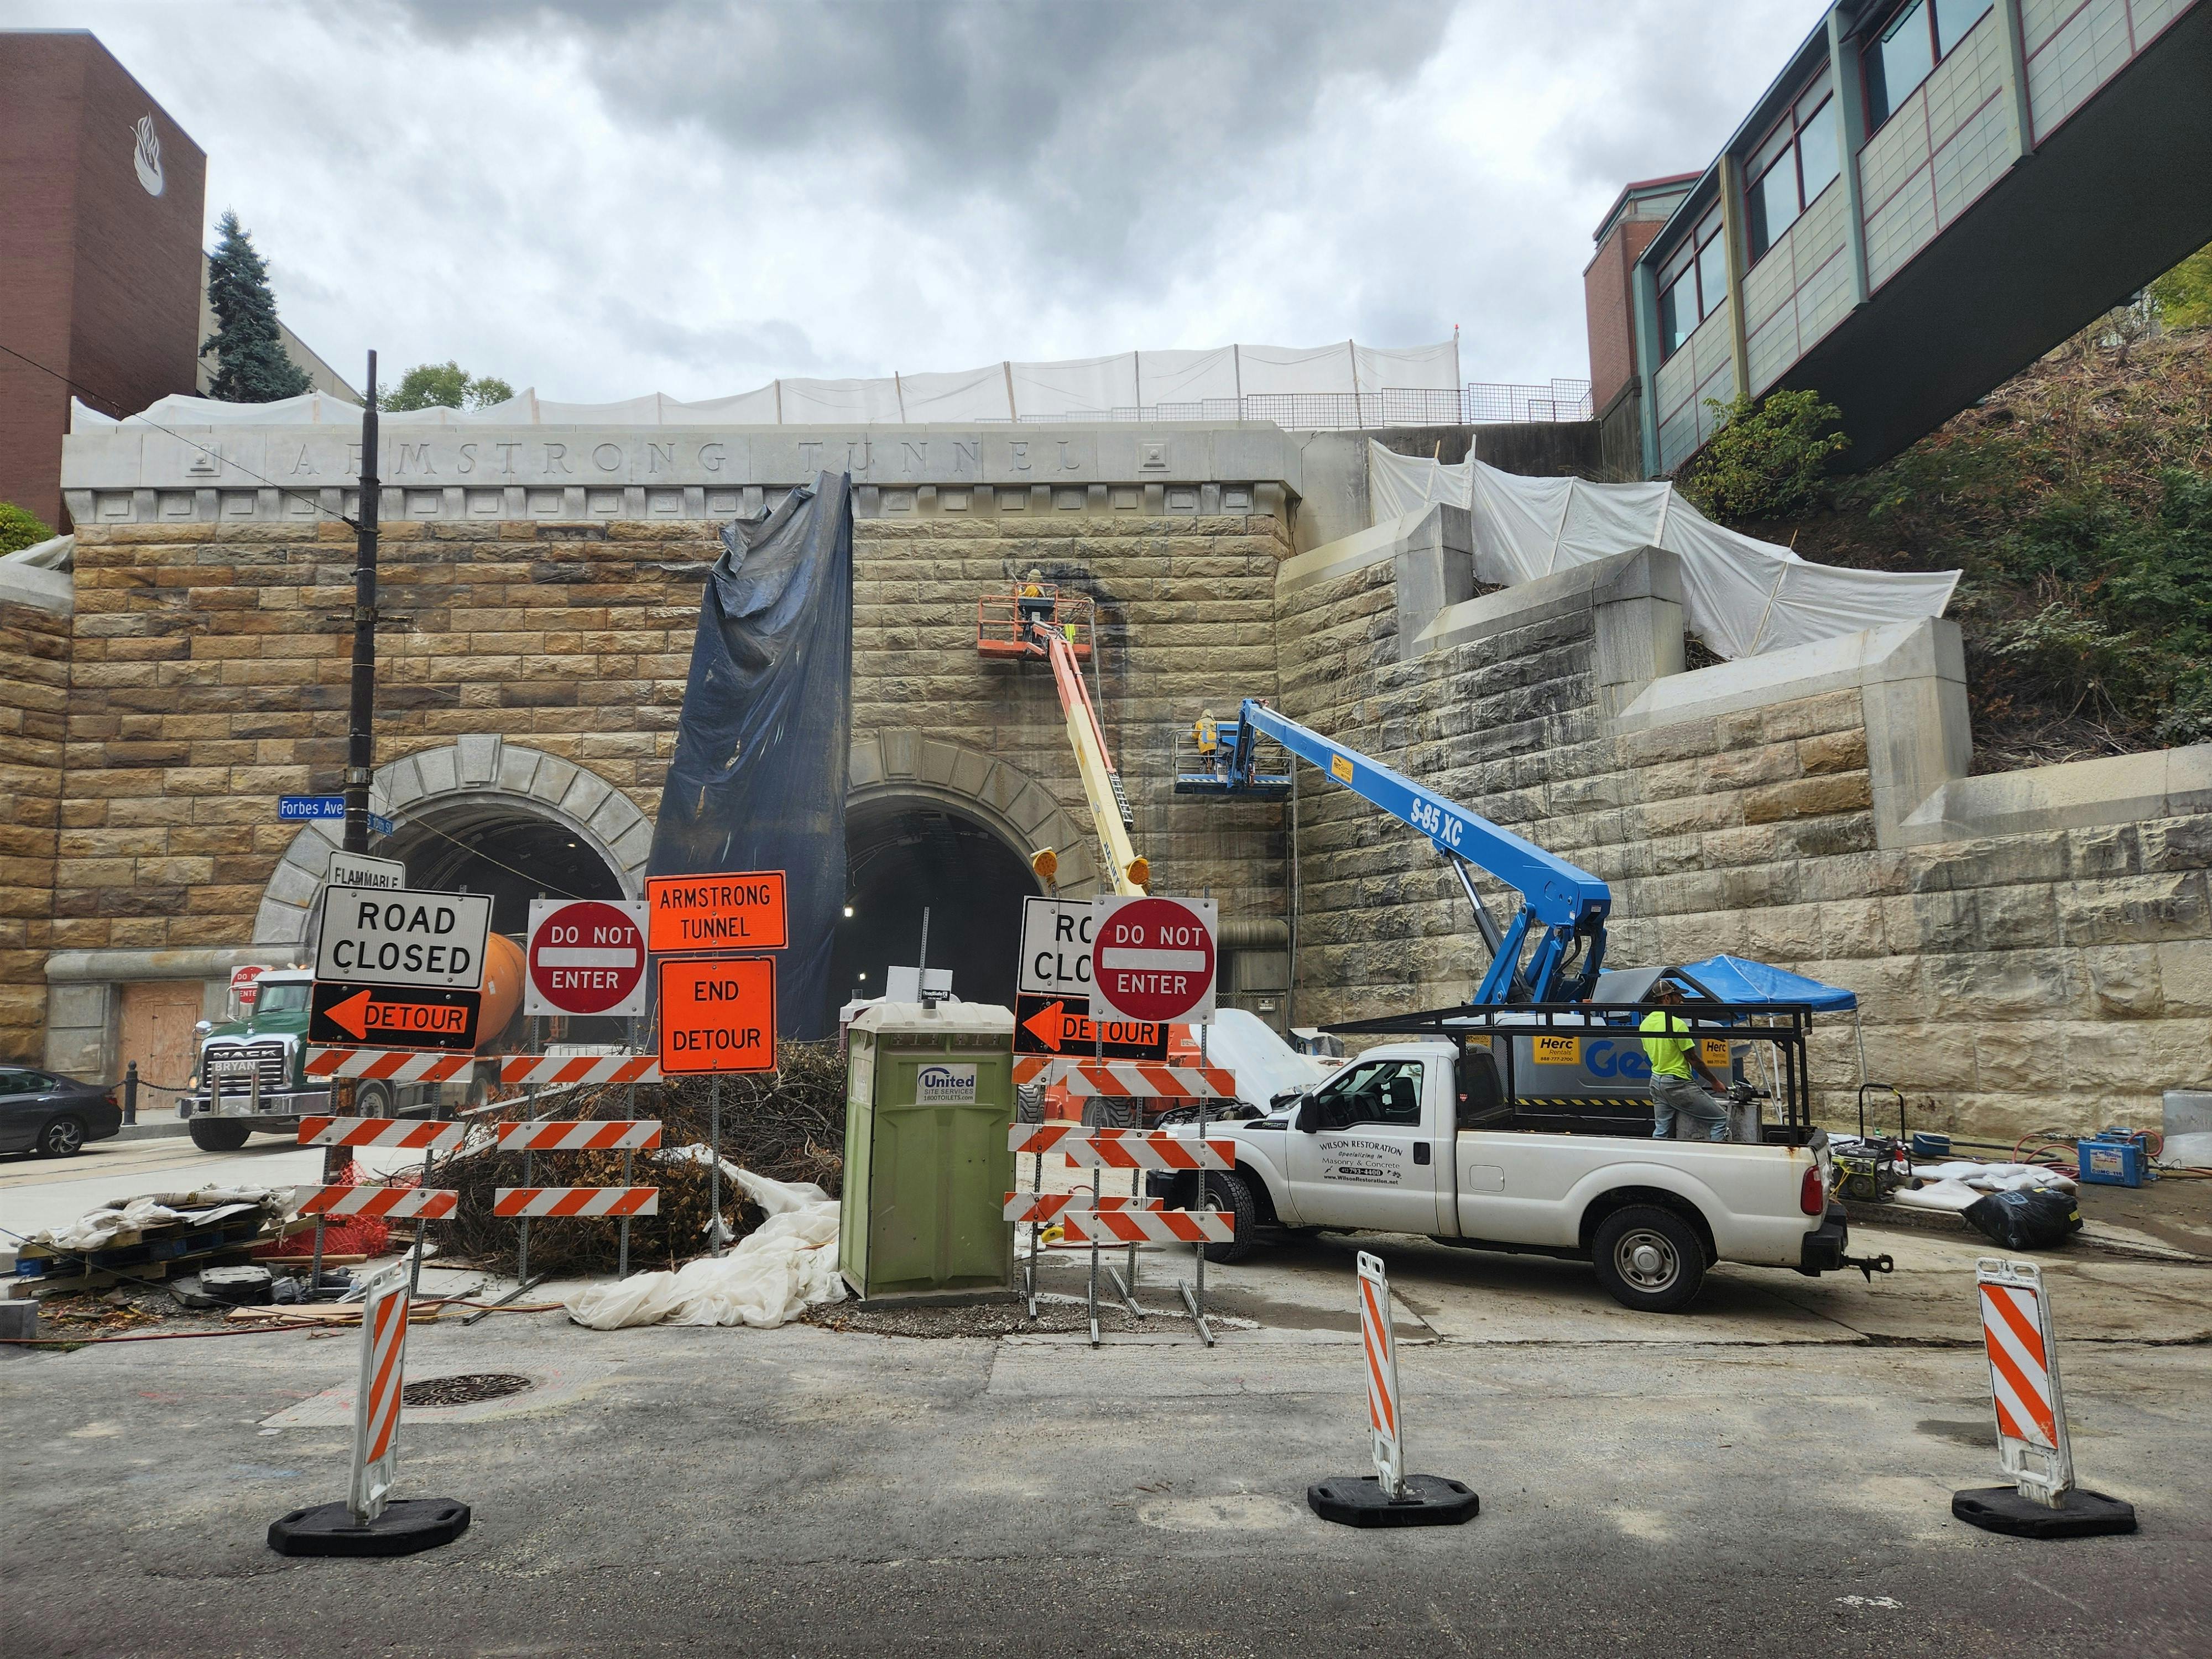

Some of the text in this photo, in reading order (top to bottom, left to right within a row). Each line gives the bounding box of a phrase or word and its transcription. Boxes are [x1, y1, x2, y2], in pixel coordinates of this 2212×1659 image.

[798, 441, 1081, 472] TUNNEL
[281, 801, 343, 815] Forbes Ave
[385, 822, 392, 834] St
[1411, 797, 1463, 847] S-85 XC
[660, 884, 770, 910] ARMSTRONG
[357, 901, 456, 934] ROAD
[551, 926, 635, 945] DO NOT
[680, 917, 750, 939] TUNNEL
[1055, 914, 1091, 943] RO
[1115, 924, 1203, 946] DO NOT
[333, 940, 470, 974] CLOSED
[1034, 951, 1091, 982] CLO
[552, 971, 618, 989] ENTER
[1117, 973, 1187, 995] ENTER
[694, 981, 739, 1001] END
[364, 1005, 464, 1031] DETOUR
[672, 1028, 761, 1051] DETOUR
[1063, 1017, 1154, 1044] DEOUR
[1540, 1038, 1574, 1049] Herc
[1707, 1041, 1726, 1052] Herc
[213, 1050, 277, 1059] MACK
[215, 1062, 255, 1071] BRYAN
[925, 1075, 974, 1087] United
[1319, 1140, 1403, 1156] WILSON RESTORATION
[1338, 1151, 1375, 1160] Specializing
[1322, 1157, 1354, 1167] Masonry
[1365, 1160, 1400, 1169] Concrete
[1323, 1175, 1399, 1185] www.WilsonRestoration.net
